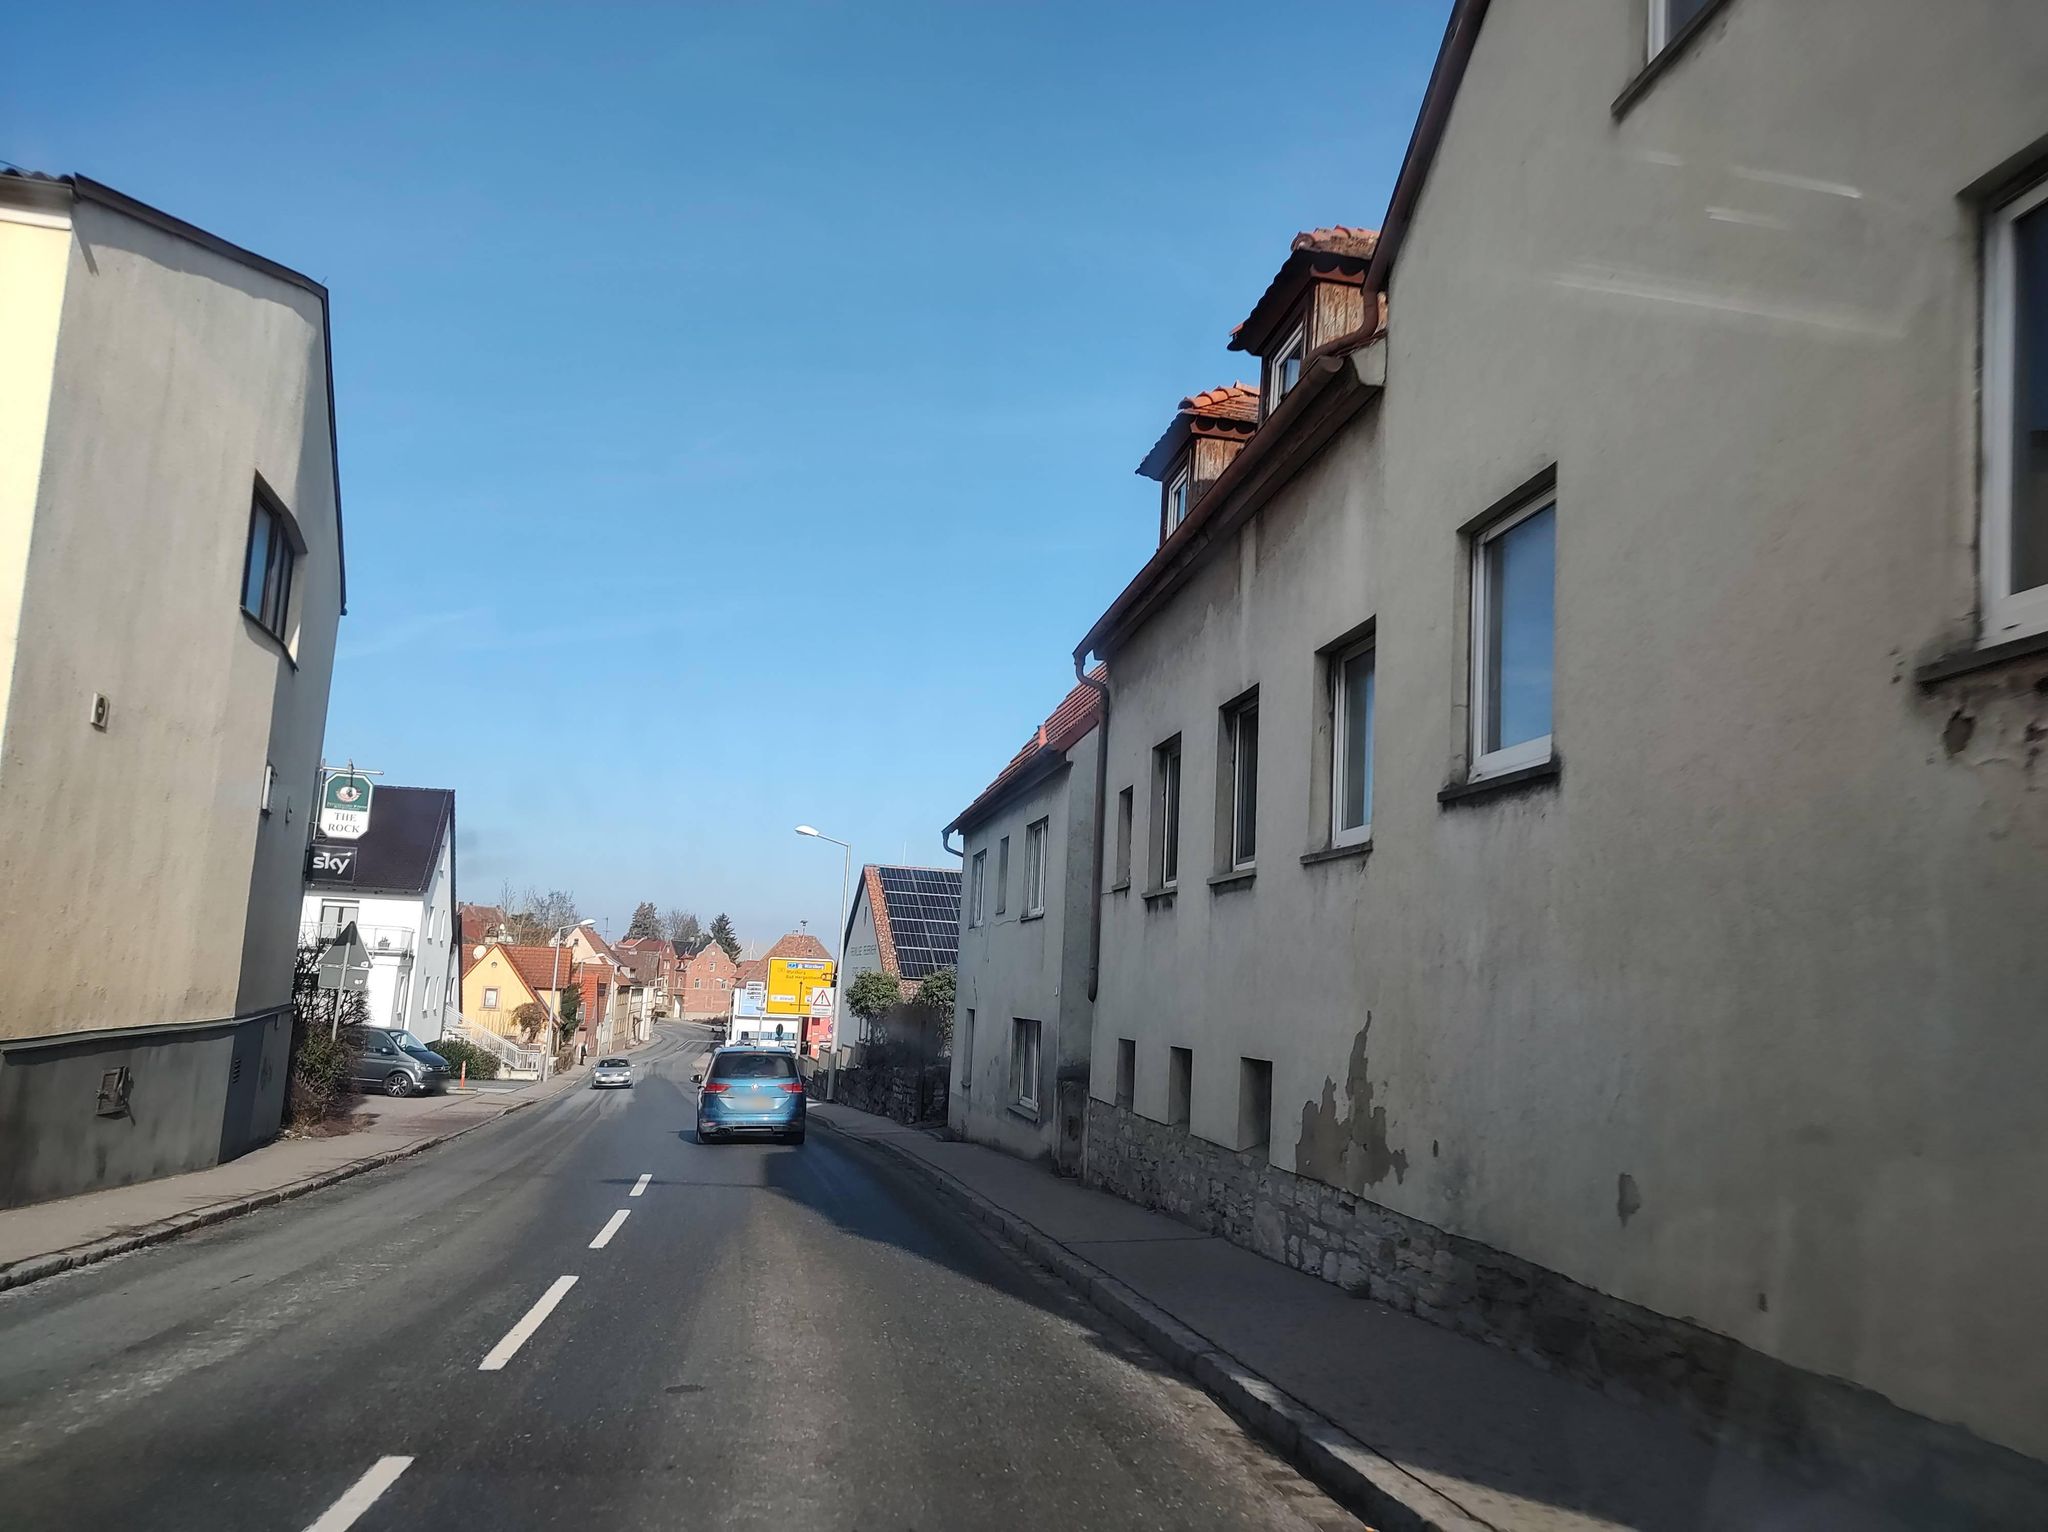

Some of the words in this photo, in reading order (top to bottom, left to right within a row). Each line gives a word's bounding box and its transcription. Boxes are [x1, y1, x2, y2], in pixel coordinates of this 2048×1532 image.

[334, 812, 357, 822] THE
[328, 823, 360, 833] ROCK
[312, 852, 351, 875] sky
